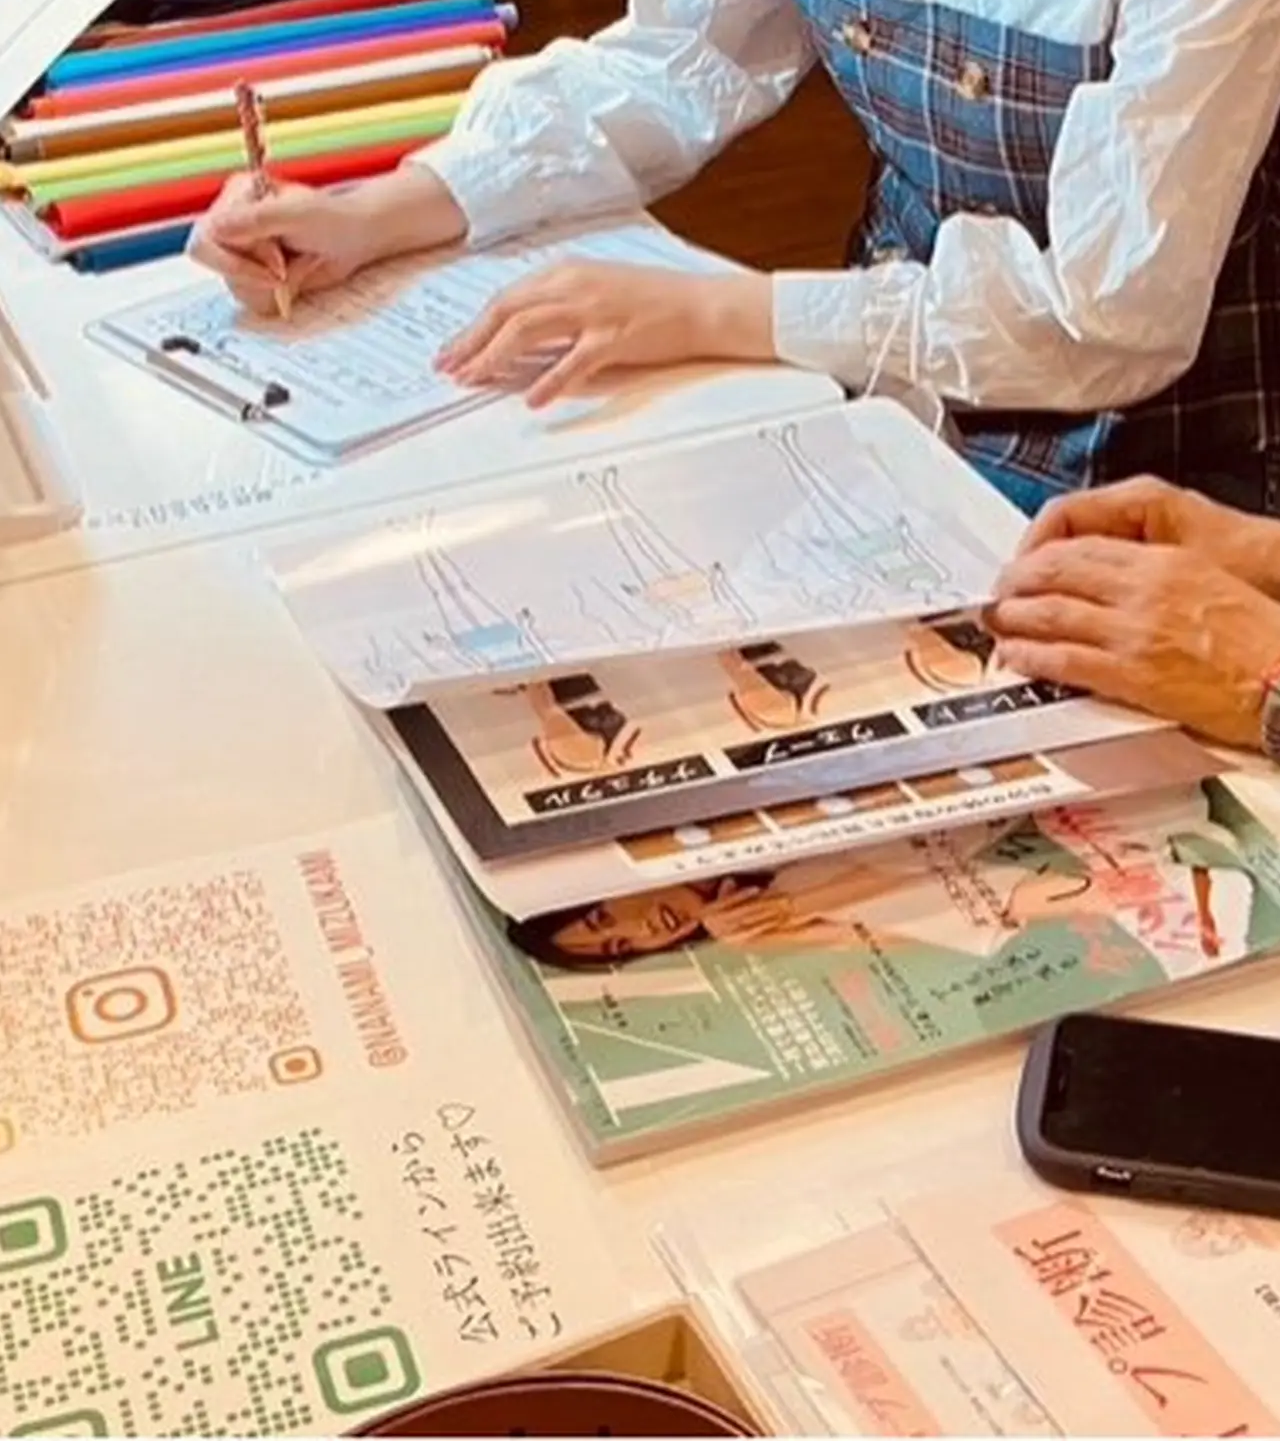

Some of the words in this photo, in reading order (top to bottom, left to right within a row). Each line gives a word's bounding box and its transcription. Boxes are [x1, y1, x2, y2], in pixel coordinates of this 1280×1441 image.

[155, 1250, 221, 1353] LINE
[391, 1131, 500, 1343] 公式ラインから
[1011, 1228, 1248, 1437] プ診断
